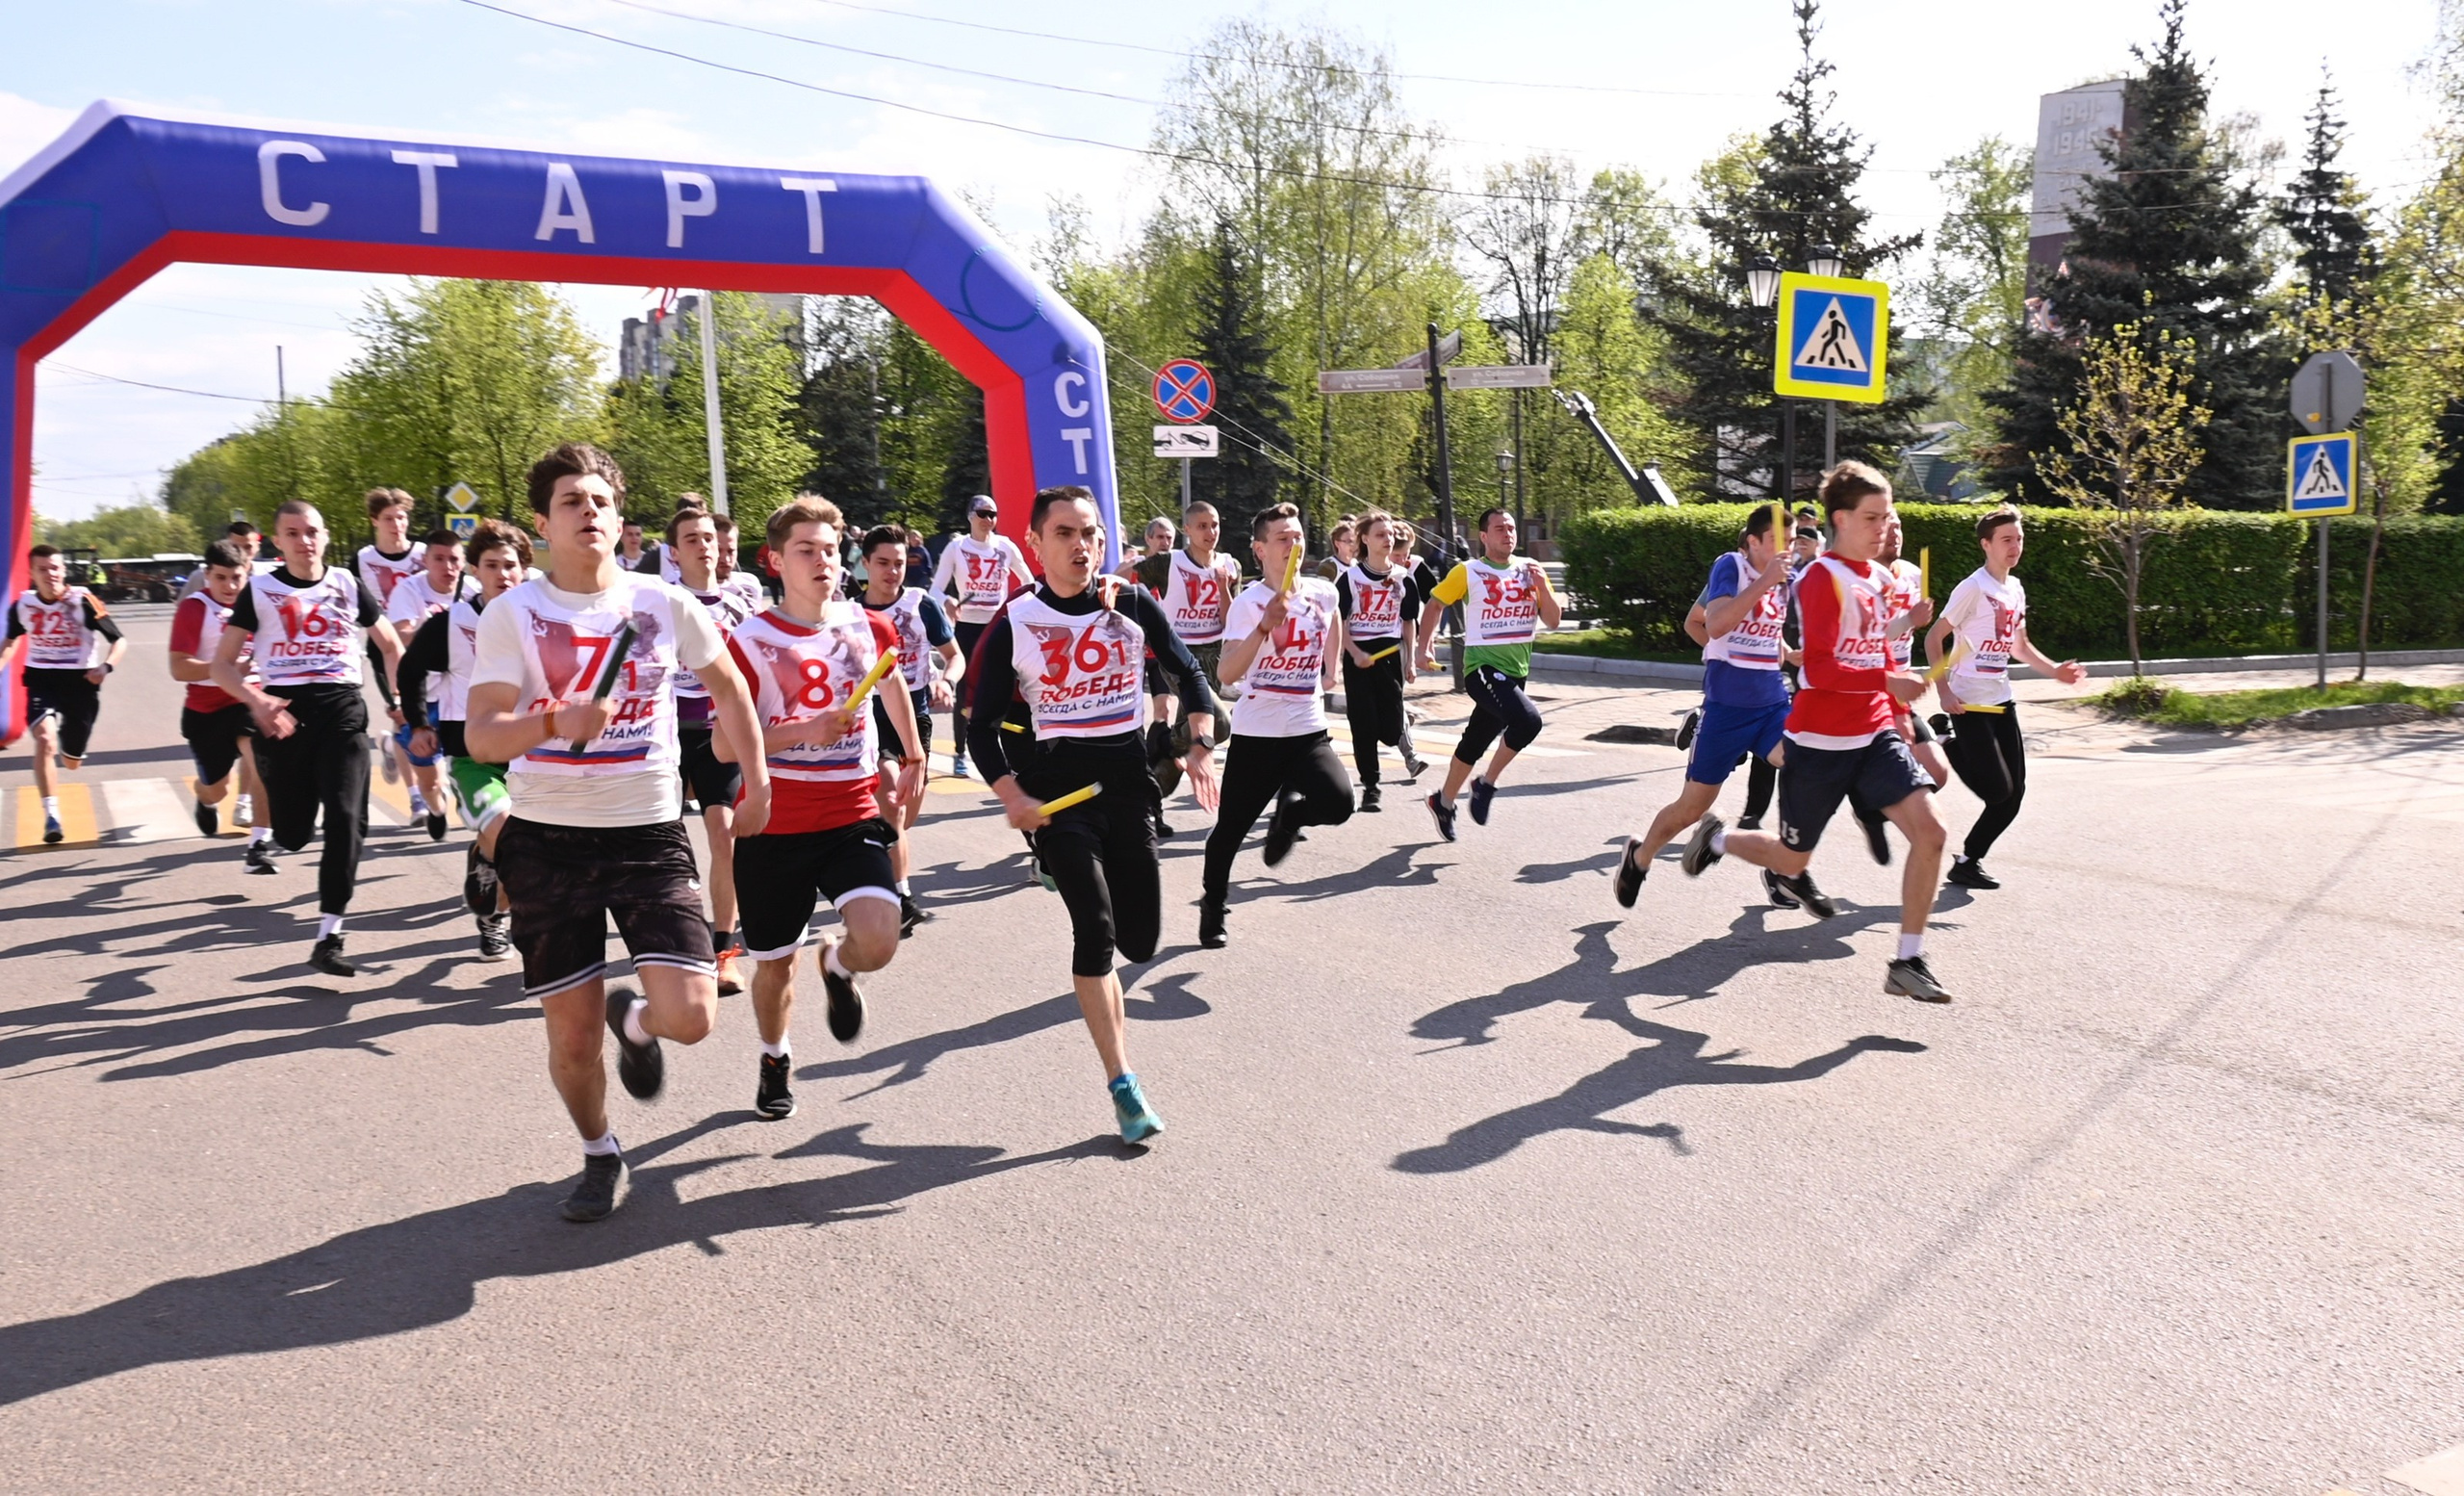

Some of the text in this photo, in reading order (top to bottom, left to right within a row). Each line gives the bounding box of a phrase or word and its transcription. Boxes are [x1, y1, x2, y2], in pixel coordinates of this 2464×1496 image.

[256, 139, 838, 254] СТАРТ
[967, 559, 998, 580] 37
[1186, 580, 1219, 606] 12
[1360, 589, 1389, 612] 17
[1482, 580, 1524, 605] 35
[278, 604, 330, 640] 16
[1176, 607, 1220, 621] ПОБЕД
[1479, 621, 1508, 630] ВСЕГДА
[1481, 606, 1536, 620] ПОБЕДА
[1286, 617, 1322, 652] 4 1
[1732, 620, 1781, 638] ПОБЕ
[1039, 625, 1127, 686] 36 1
[1838, 637, 1885, 655] ПОБЕ
[570, 636, 637, 692] 7 1
[799, 658, 834, 709] 8
[527, 697, 655, 726] ПДА
[1781, 819, 1800, 845] 13
